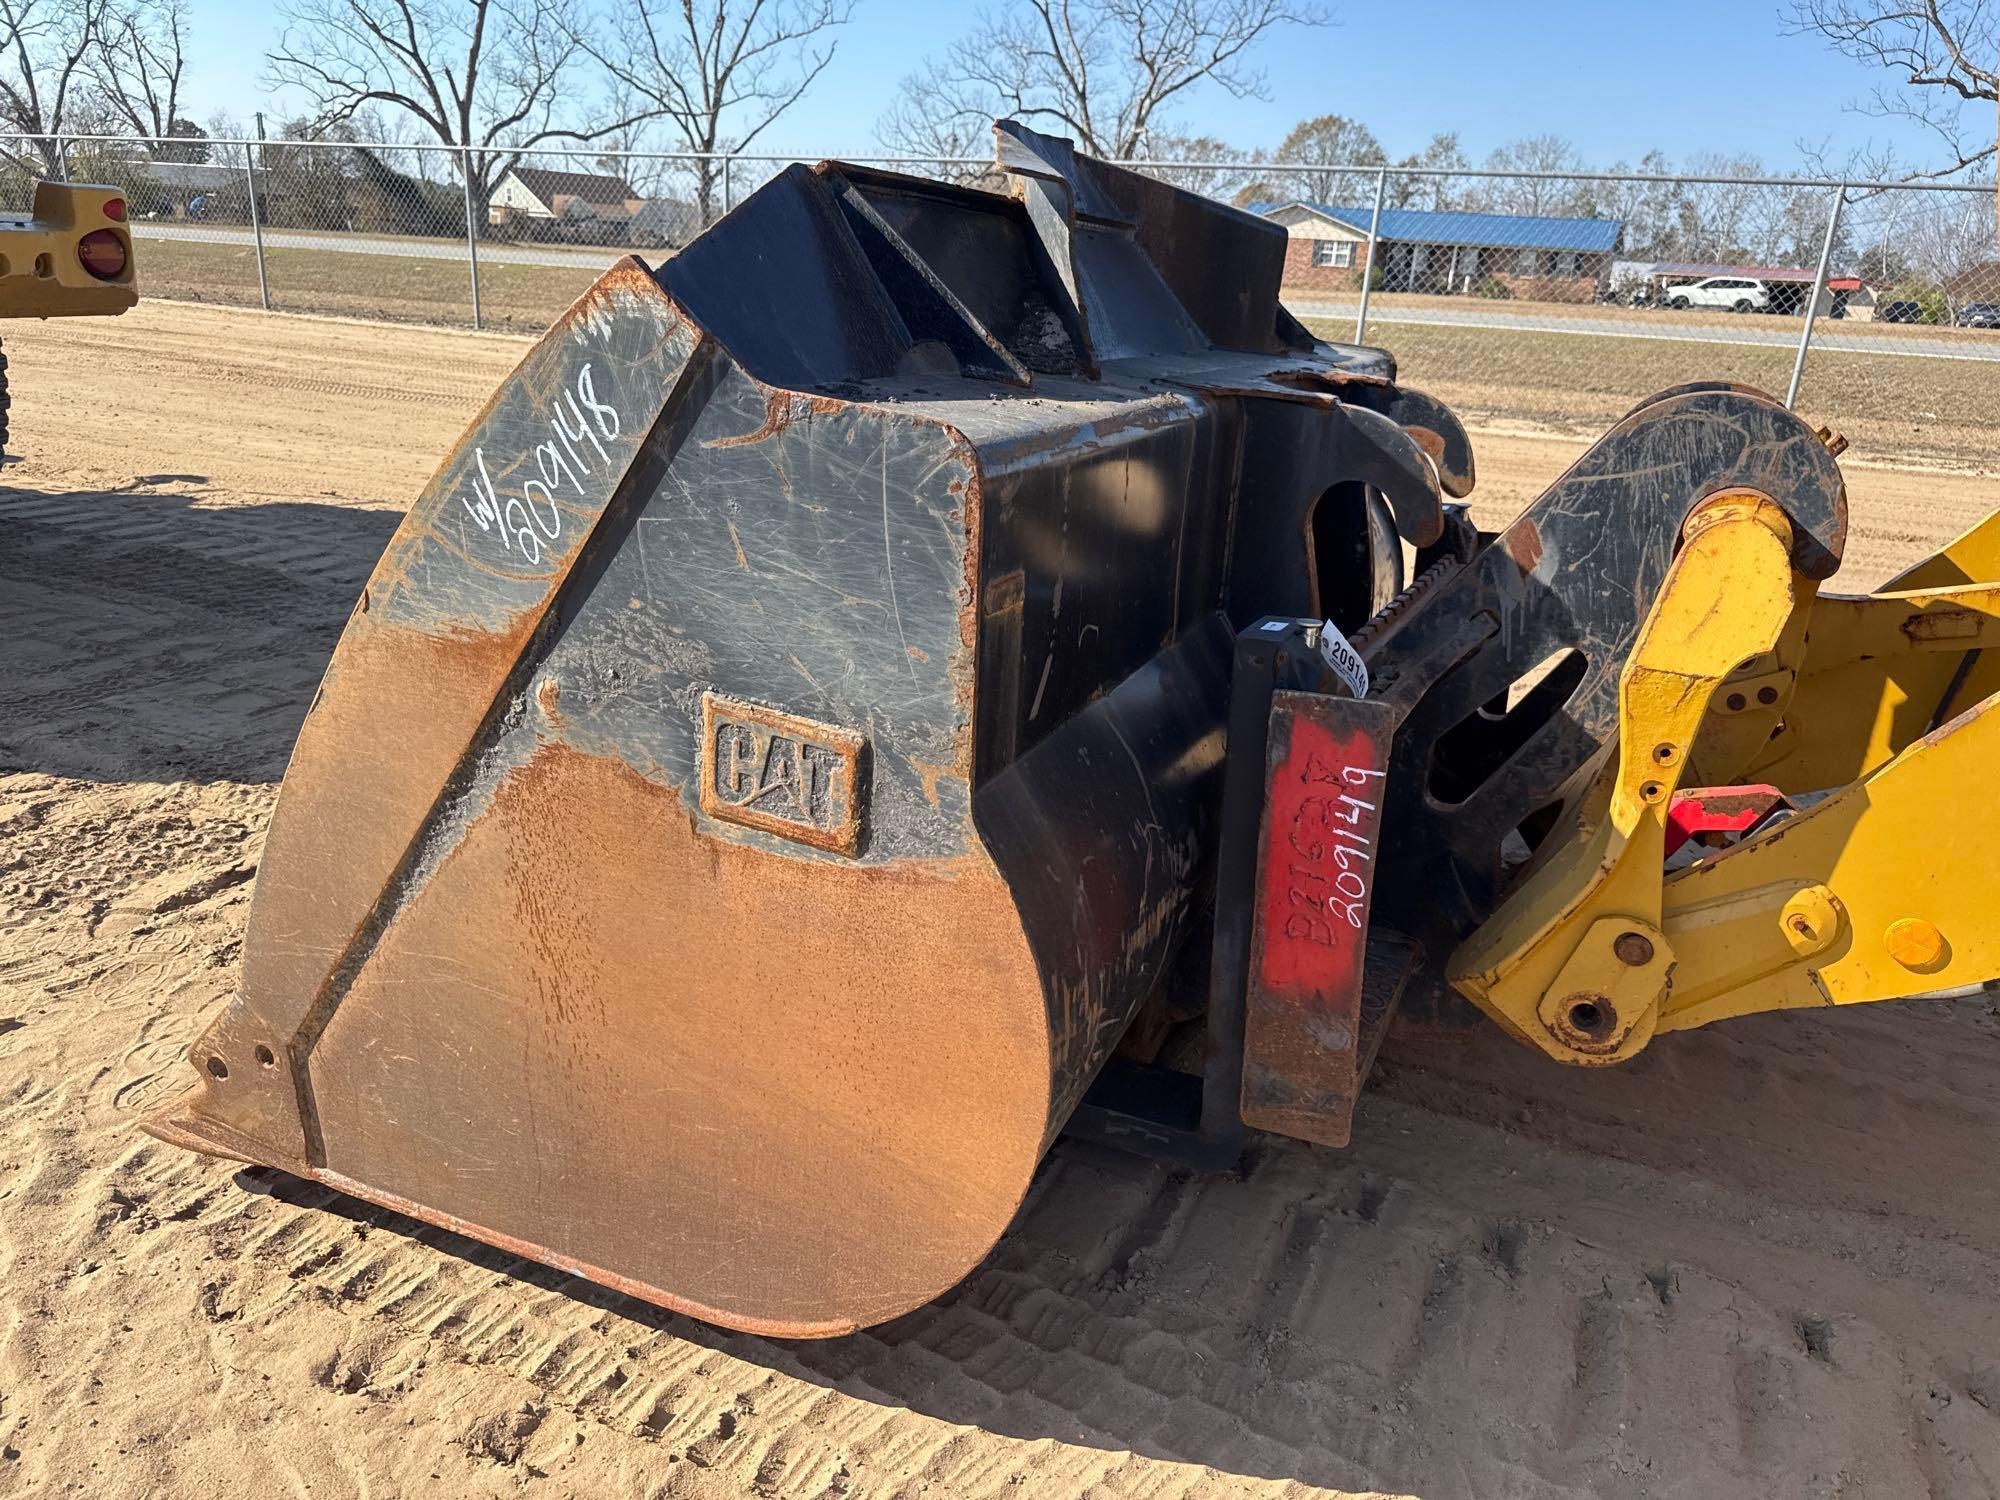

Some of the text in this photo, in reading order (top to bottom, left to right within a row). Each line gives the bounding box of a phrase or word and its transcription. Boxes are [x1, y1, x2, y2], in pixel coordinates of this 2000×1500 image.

[505, 362, 620, 565] 209148
[715, 723, 845, 833] CAT
[1329, 765, 1387, 928] 209149
